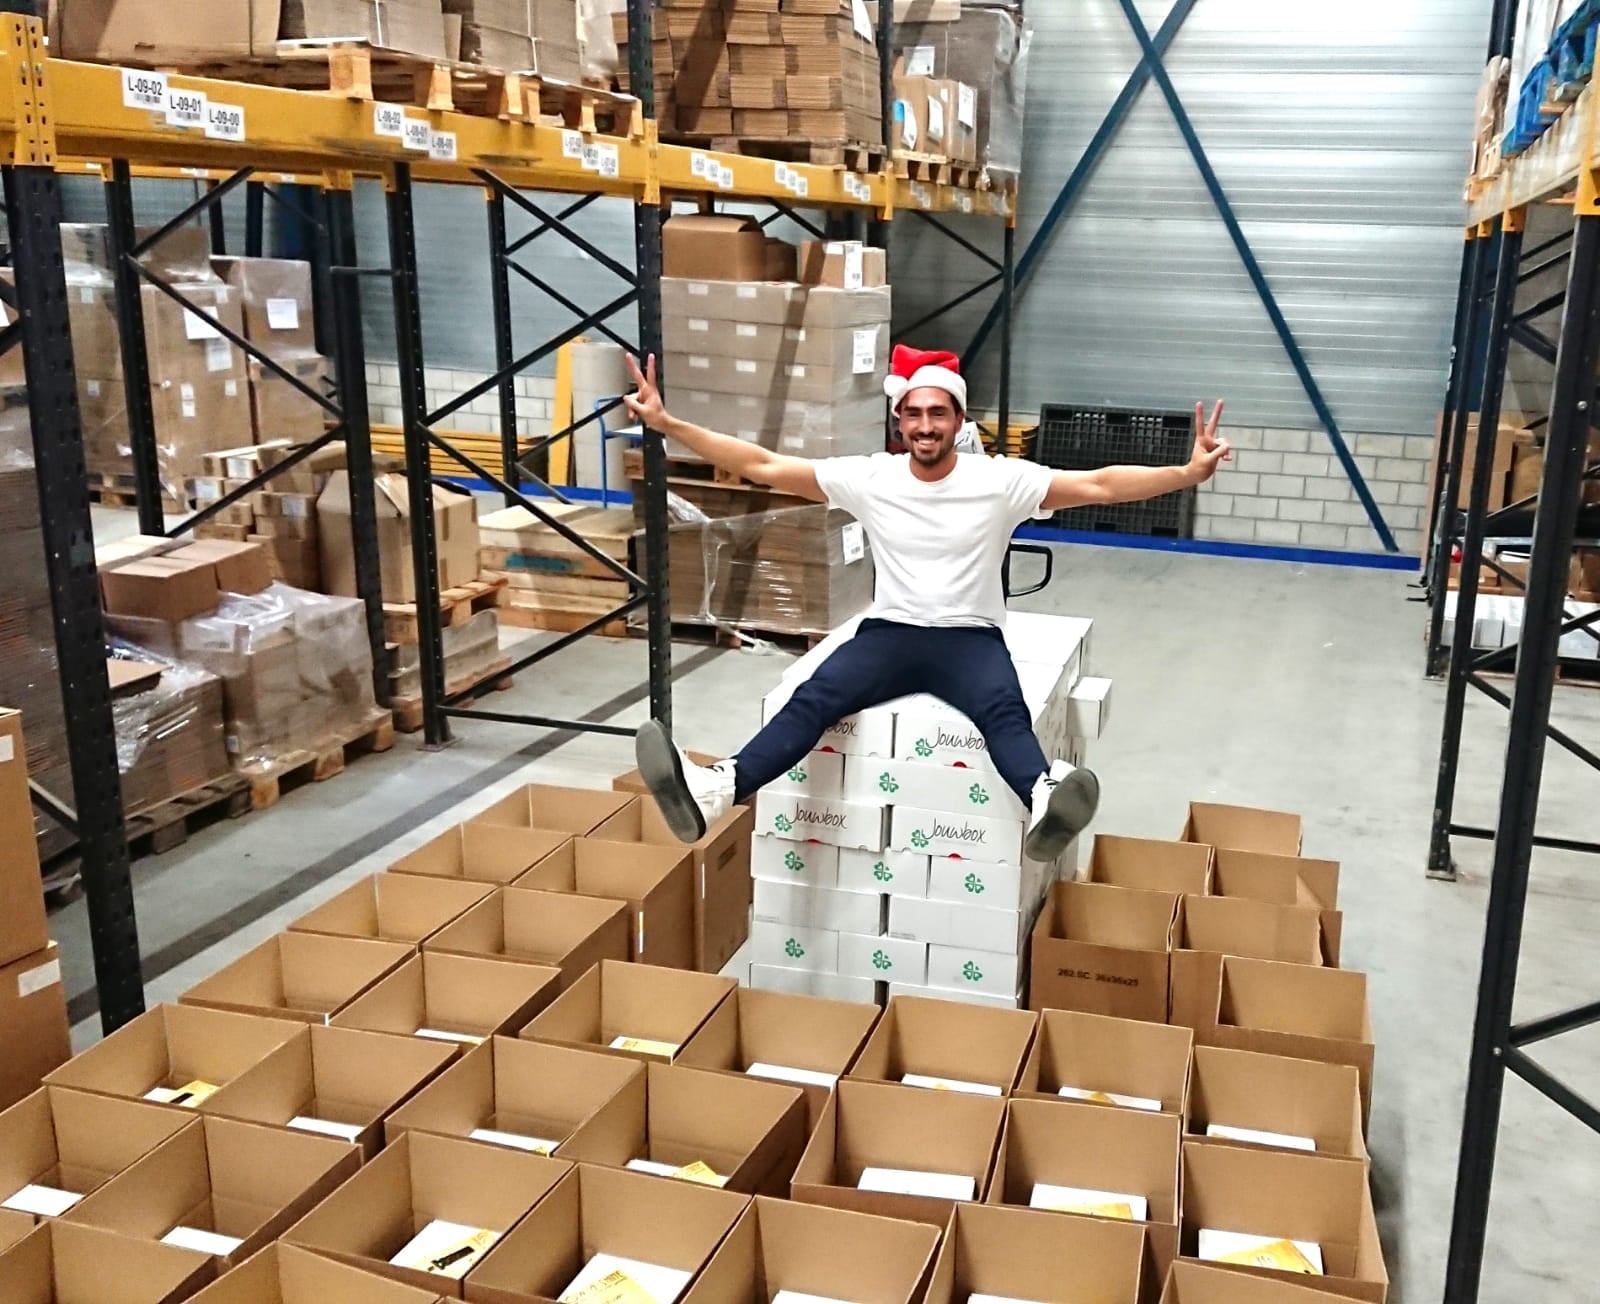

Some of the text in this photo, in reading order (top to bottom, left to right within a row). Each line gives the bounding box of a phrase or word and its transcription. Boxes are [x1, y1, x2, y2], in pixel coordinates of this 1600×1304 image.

[128, 75, 163, 96] L-09-02
[169, 95, 202, 112] L-09-01
[208, 108, 240, 127] L-09-00
[784, 801, 848, 830] Jouwbox
[920, 817, 988, 844] Jouwbox
